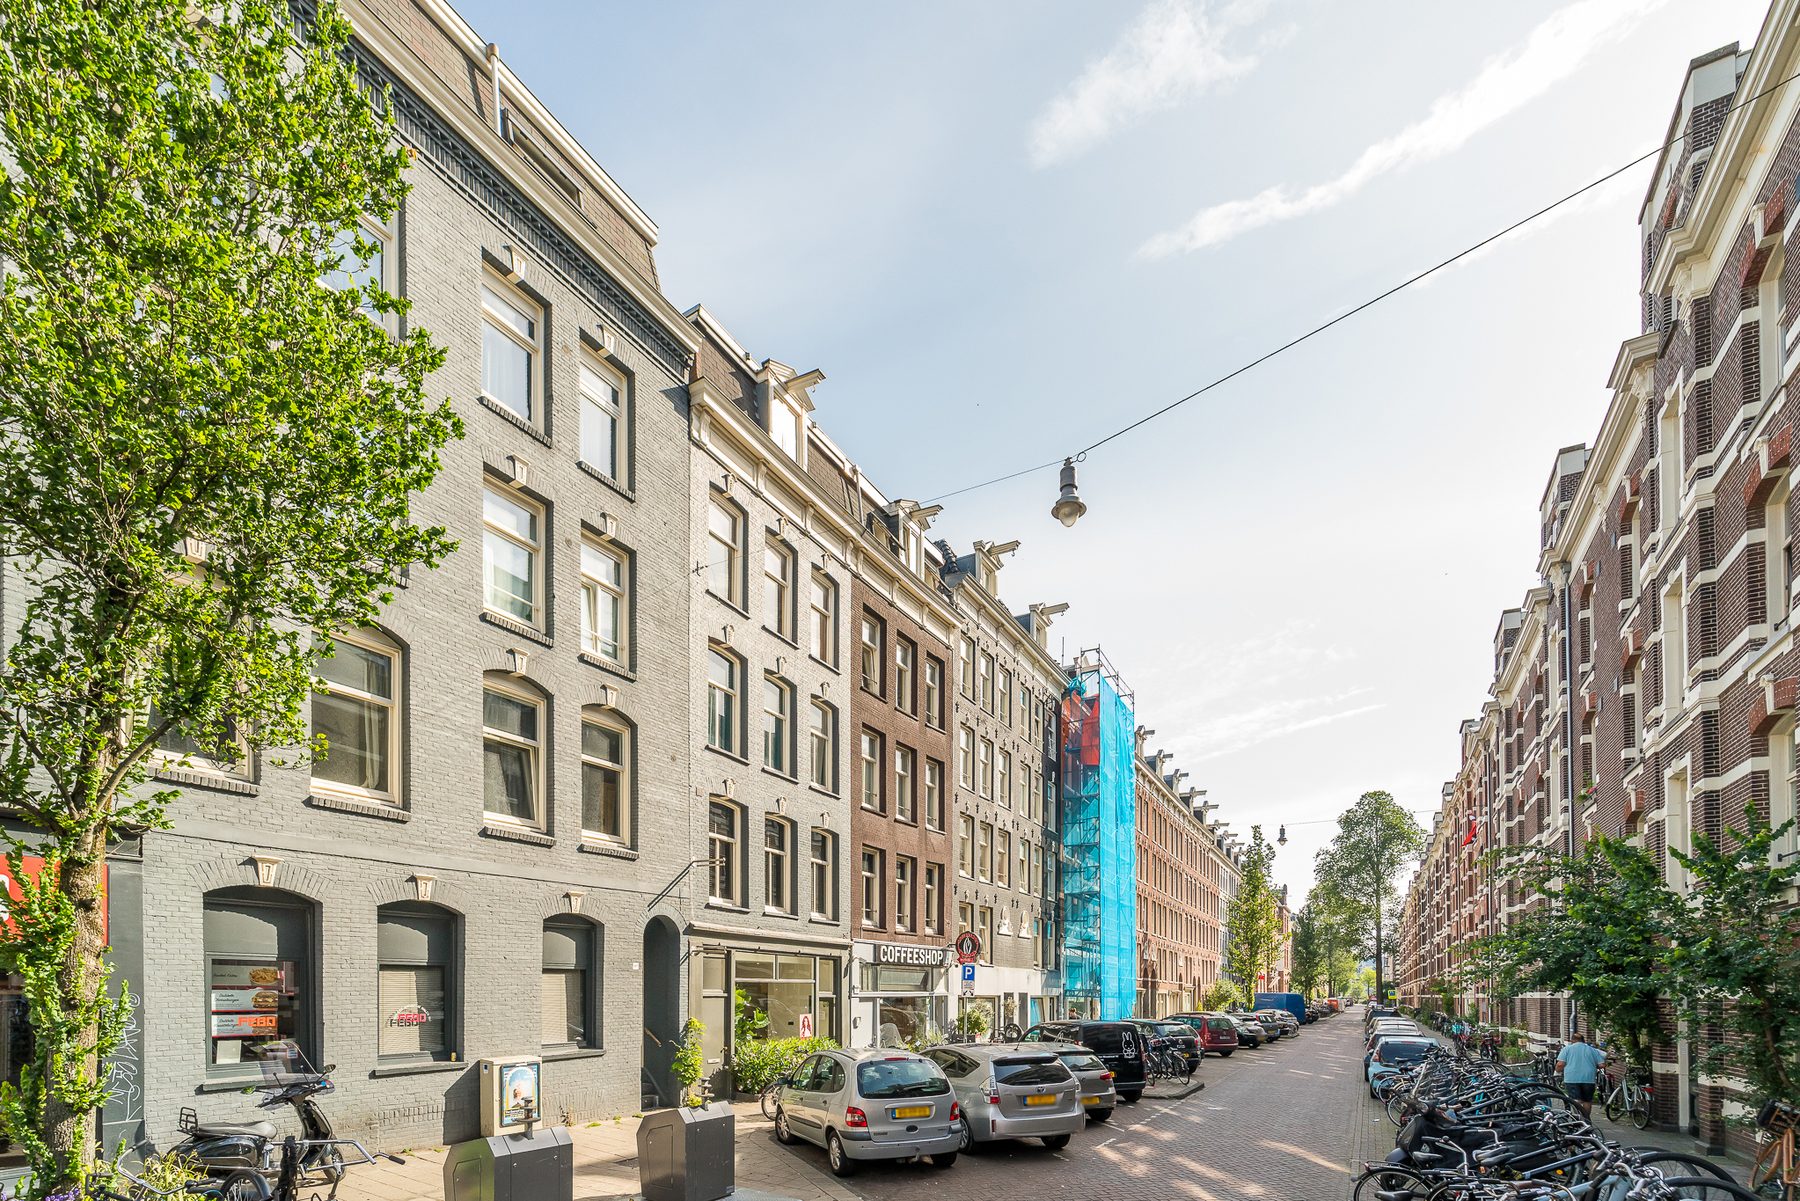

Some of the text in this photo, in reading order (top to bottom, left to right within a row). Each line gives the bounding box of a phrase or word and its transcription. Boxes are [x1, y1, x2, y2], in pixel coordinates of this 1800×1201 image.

[880, 945, 943, 965] COFFEESHOP
[965, 967, 973, 979] P
[238, 1016, 276, 1026] FEBO
